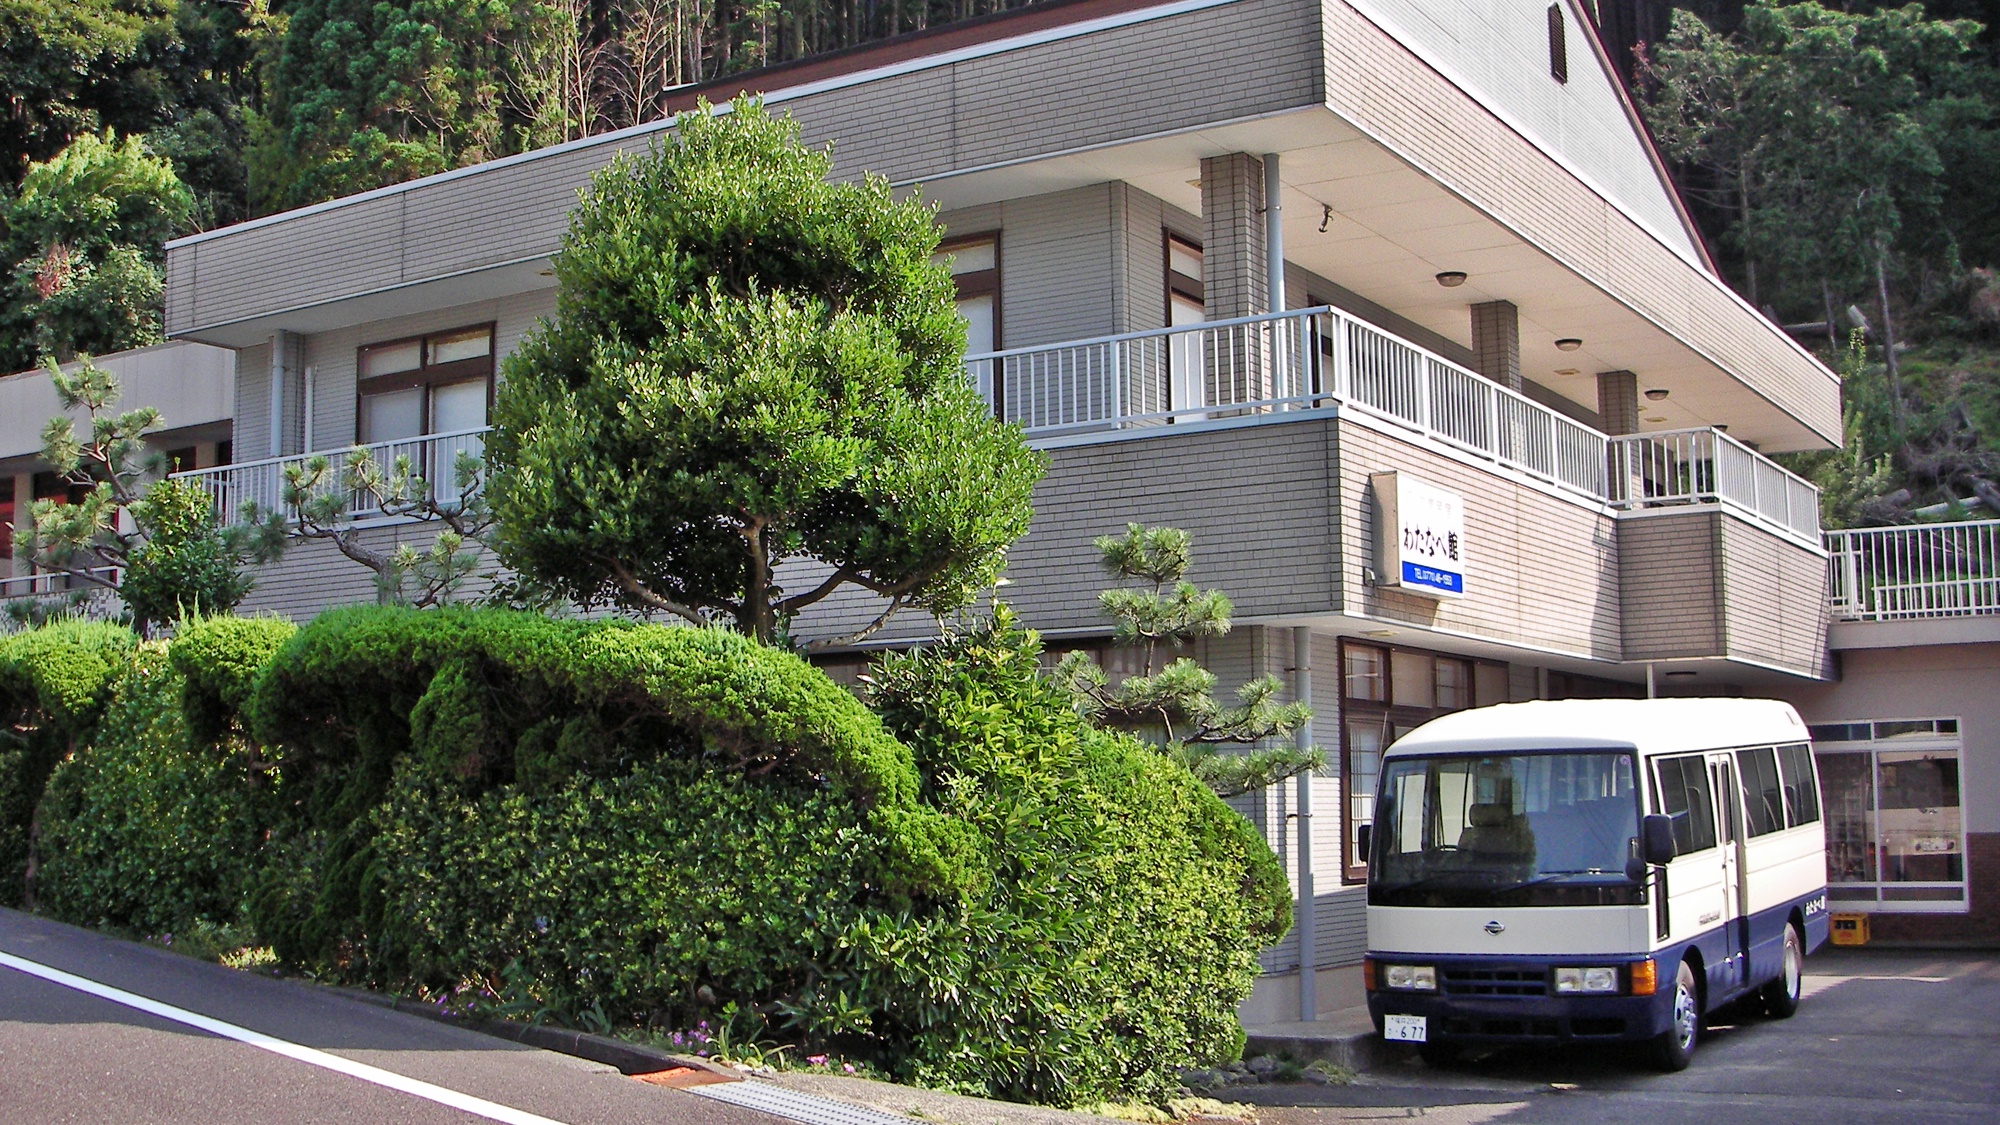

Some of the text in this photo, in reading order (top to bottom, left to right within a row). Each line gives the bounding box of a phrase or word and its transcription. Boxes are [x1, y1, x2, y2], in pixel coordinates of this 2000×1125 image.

[1403, 521, 1458, 562] わたなべ館
